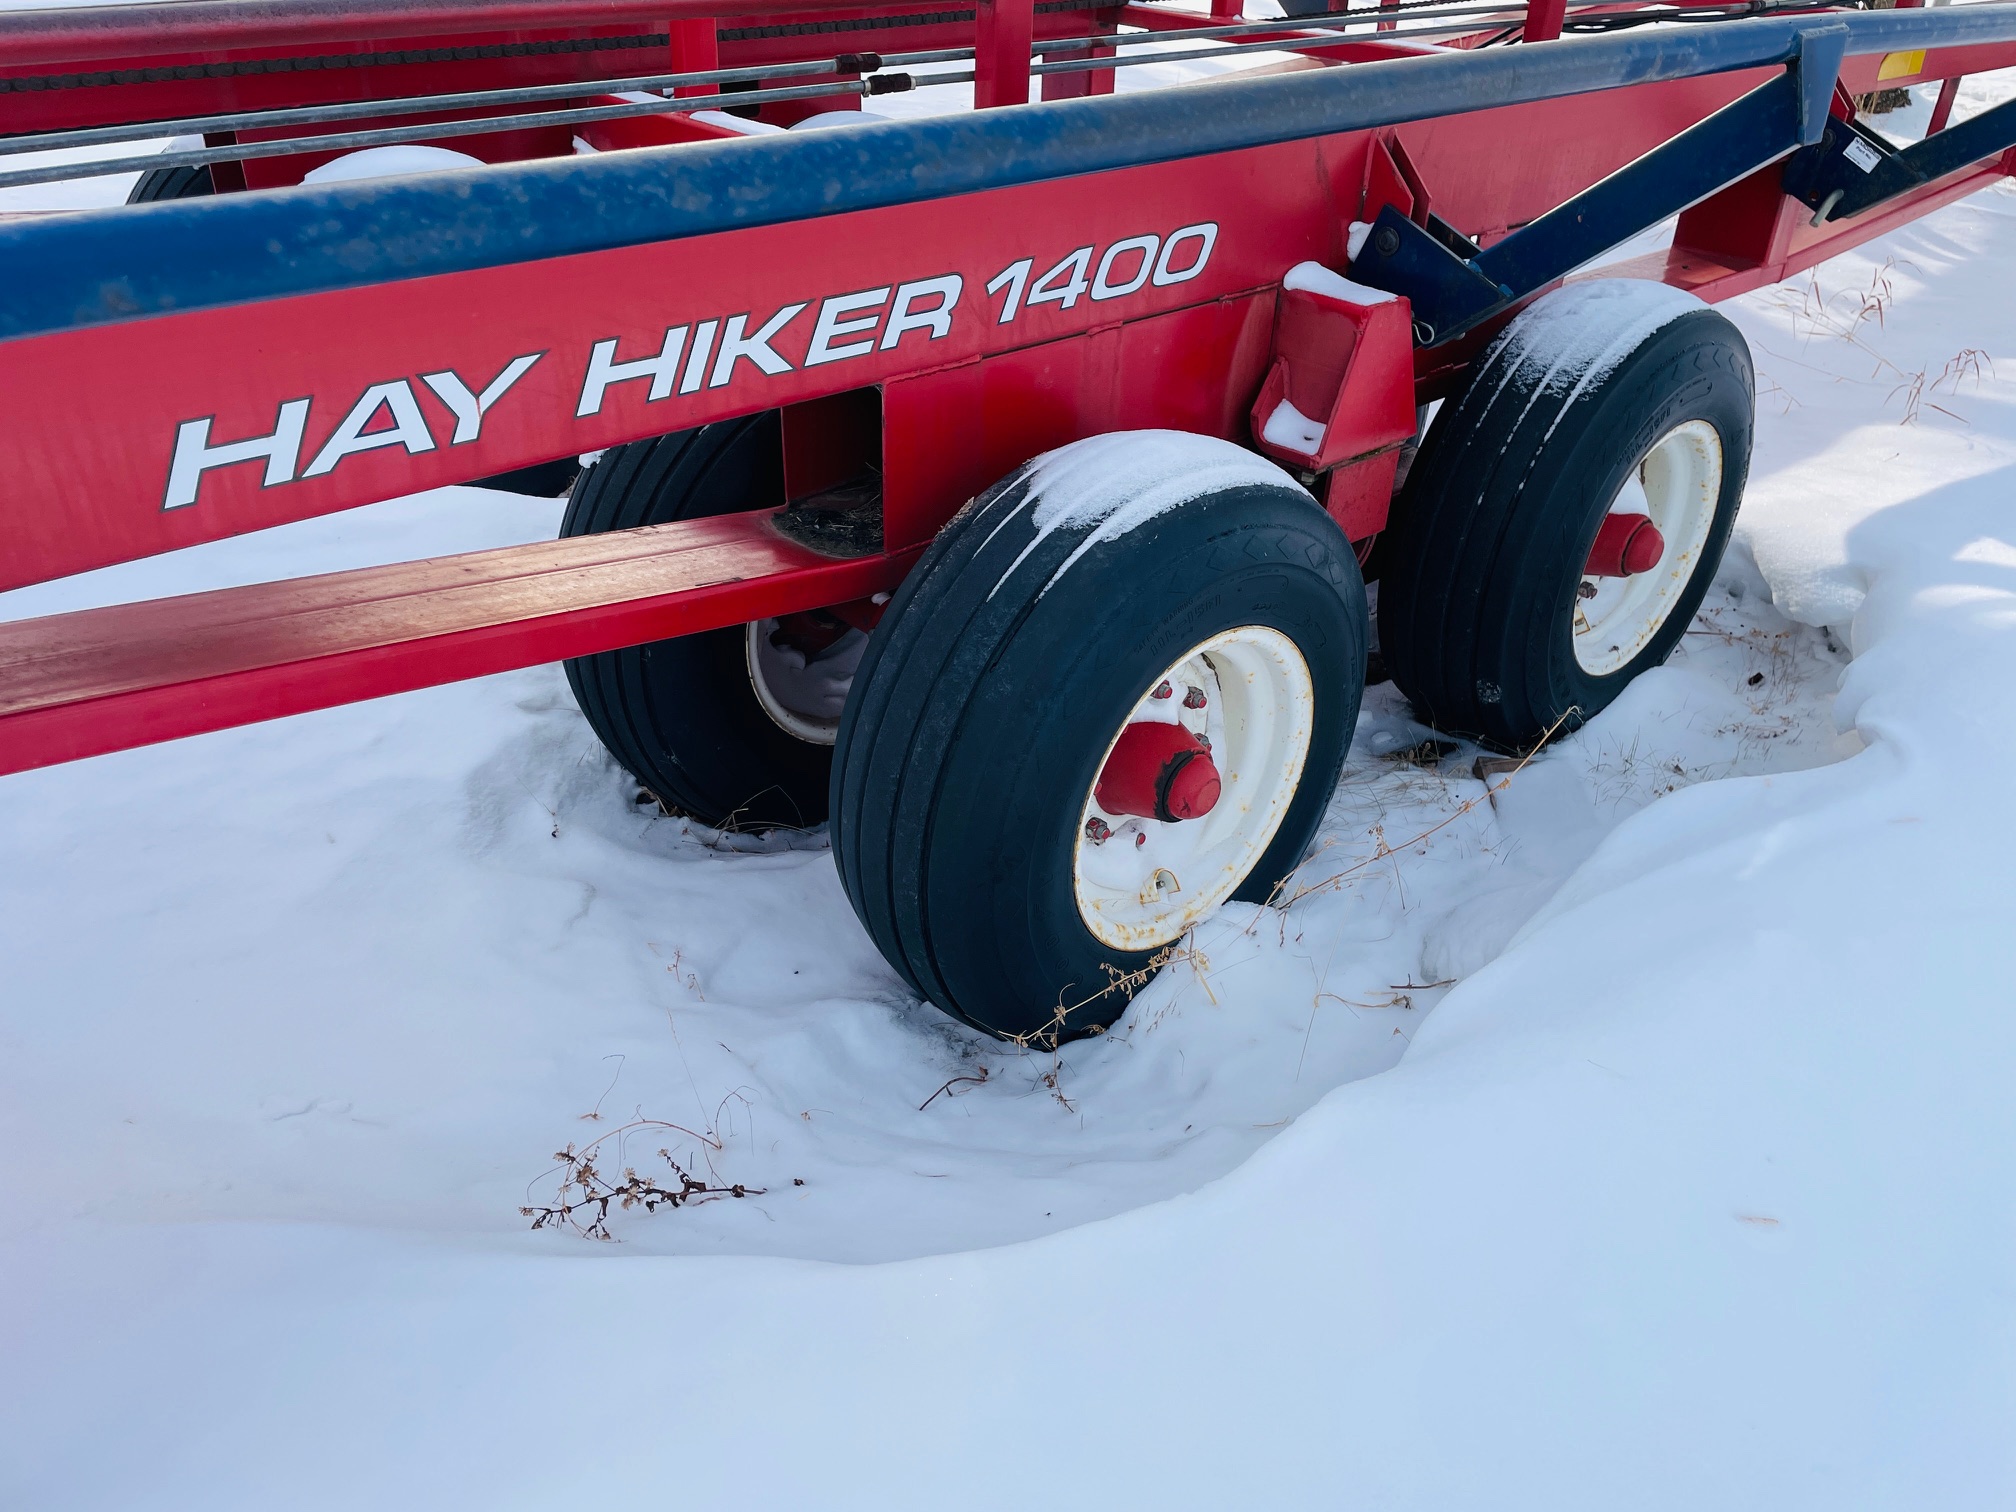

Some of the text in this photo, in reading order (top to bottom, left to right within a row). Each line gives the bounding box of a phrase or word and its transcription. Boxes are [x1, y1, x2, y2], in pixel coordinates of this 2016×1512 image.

[163, 221, 1220, 511] HAY HIKER 1400
[1162, 597, 1195, 626] WARNING
